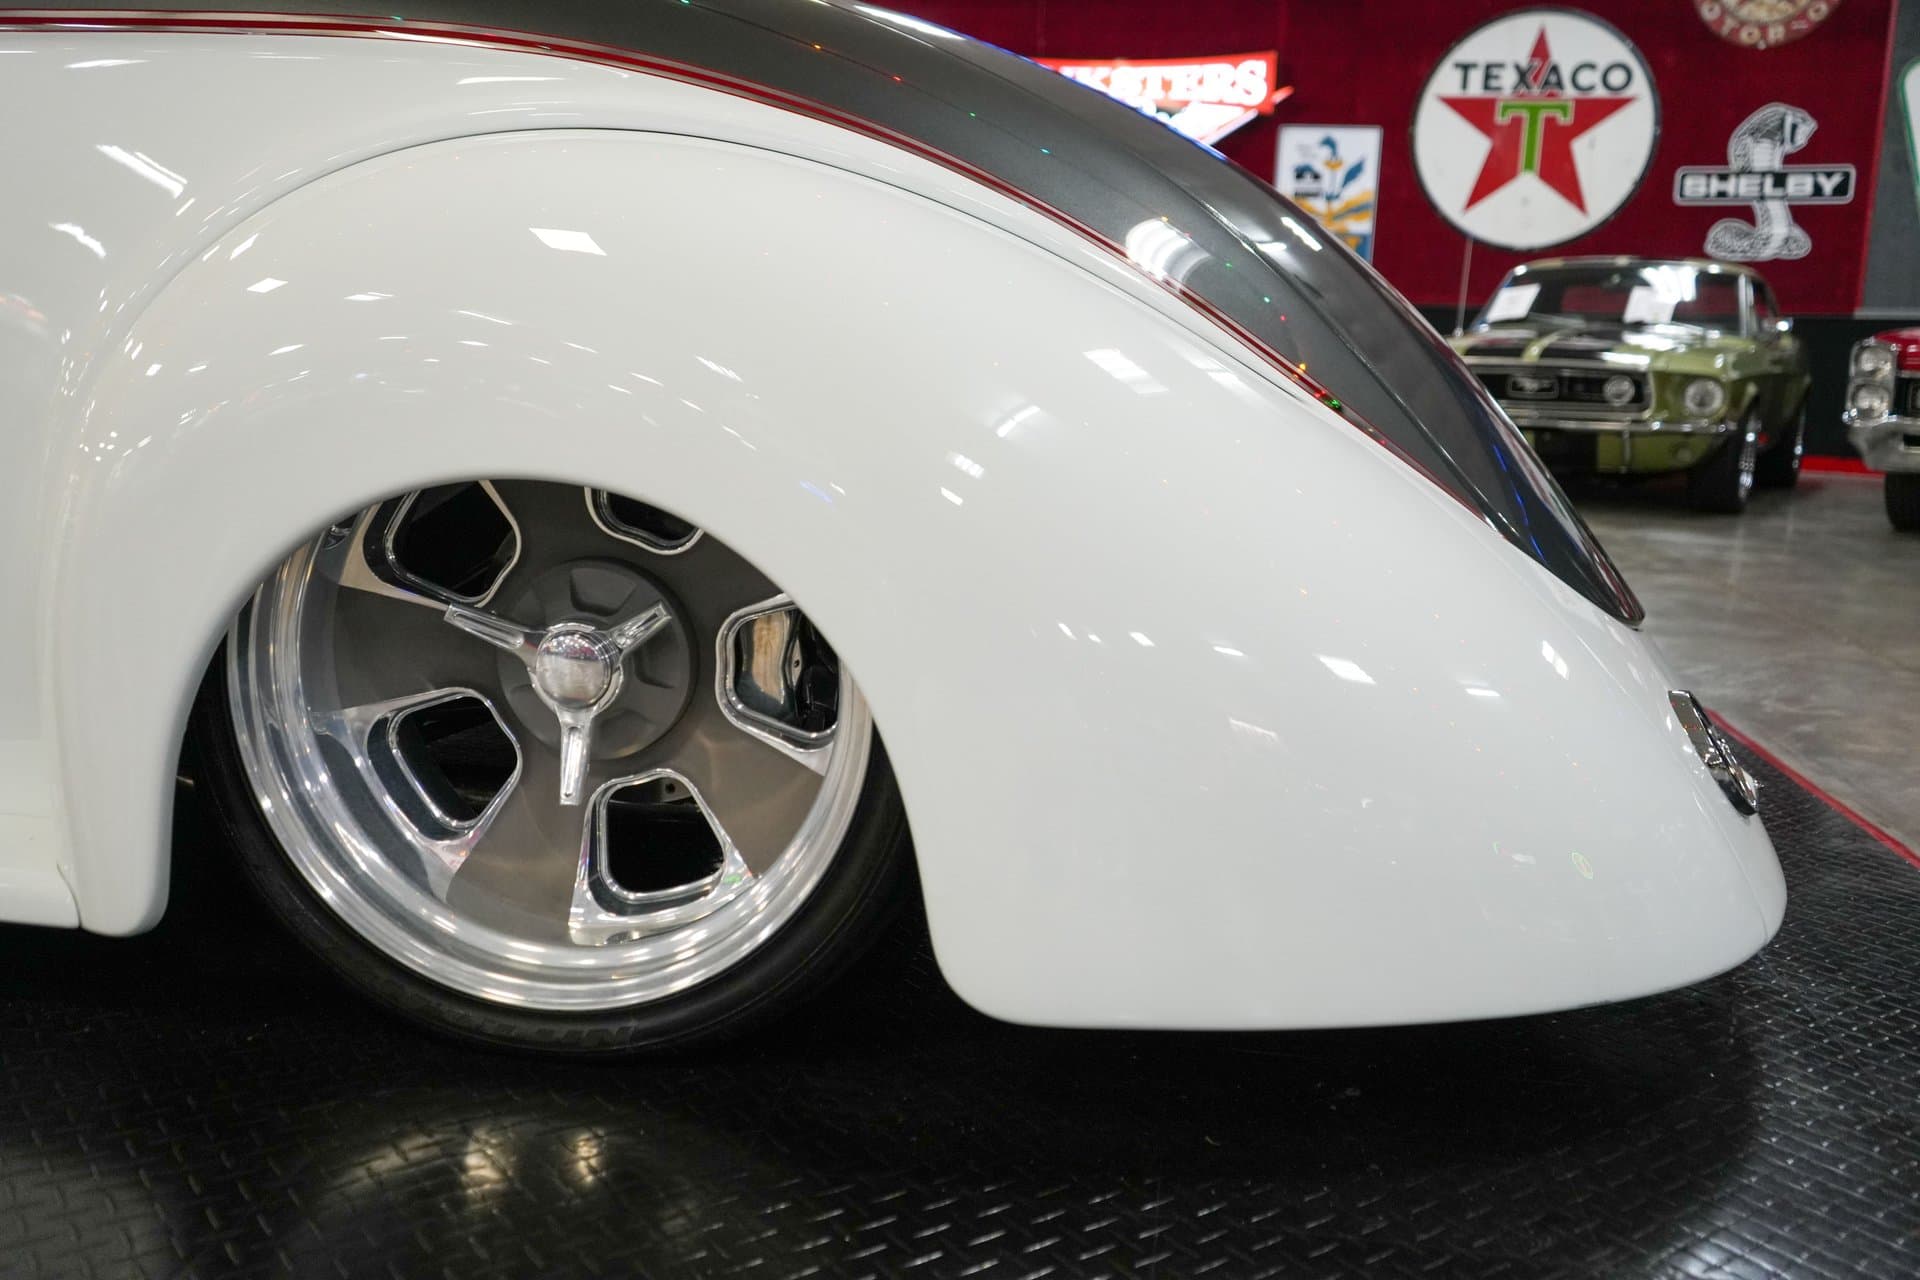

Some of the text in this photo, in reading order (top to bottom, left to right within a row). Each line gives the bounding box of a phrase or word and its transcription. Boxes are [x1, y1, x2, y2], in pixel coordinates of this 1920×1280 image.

[1454, 62, 1633, 92] TEXACO
[1497, 99, 1574, 174] T
[1681, 172, 1845, 199] SHELBY
